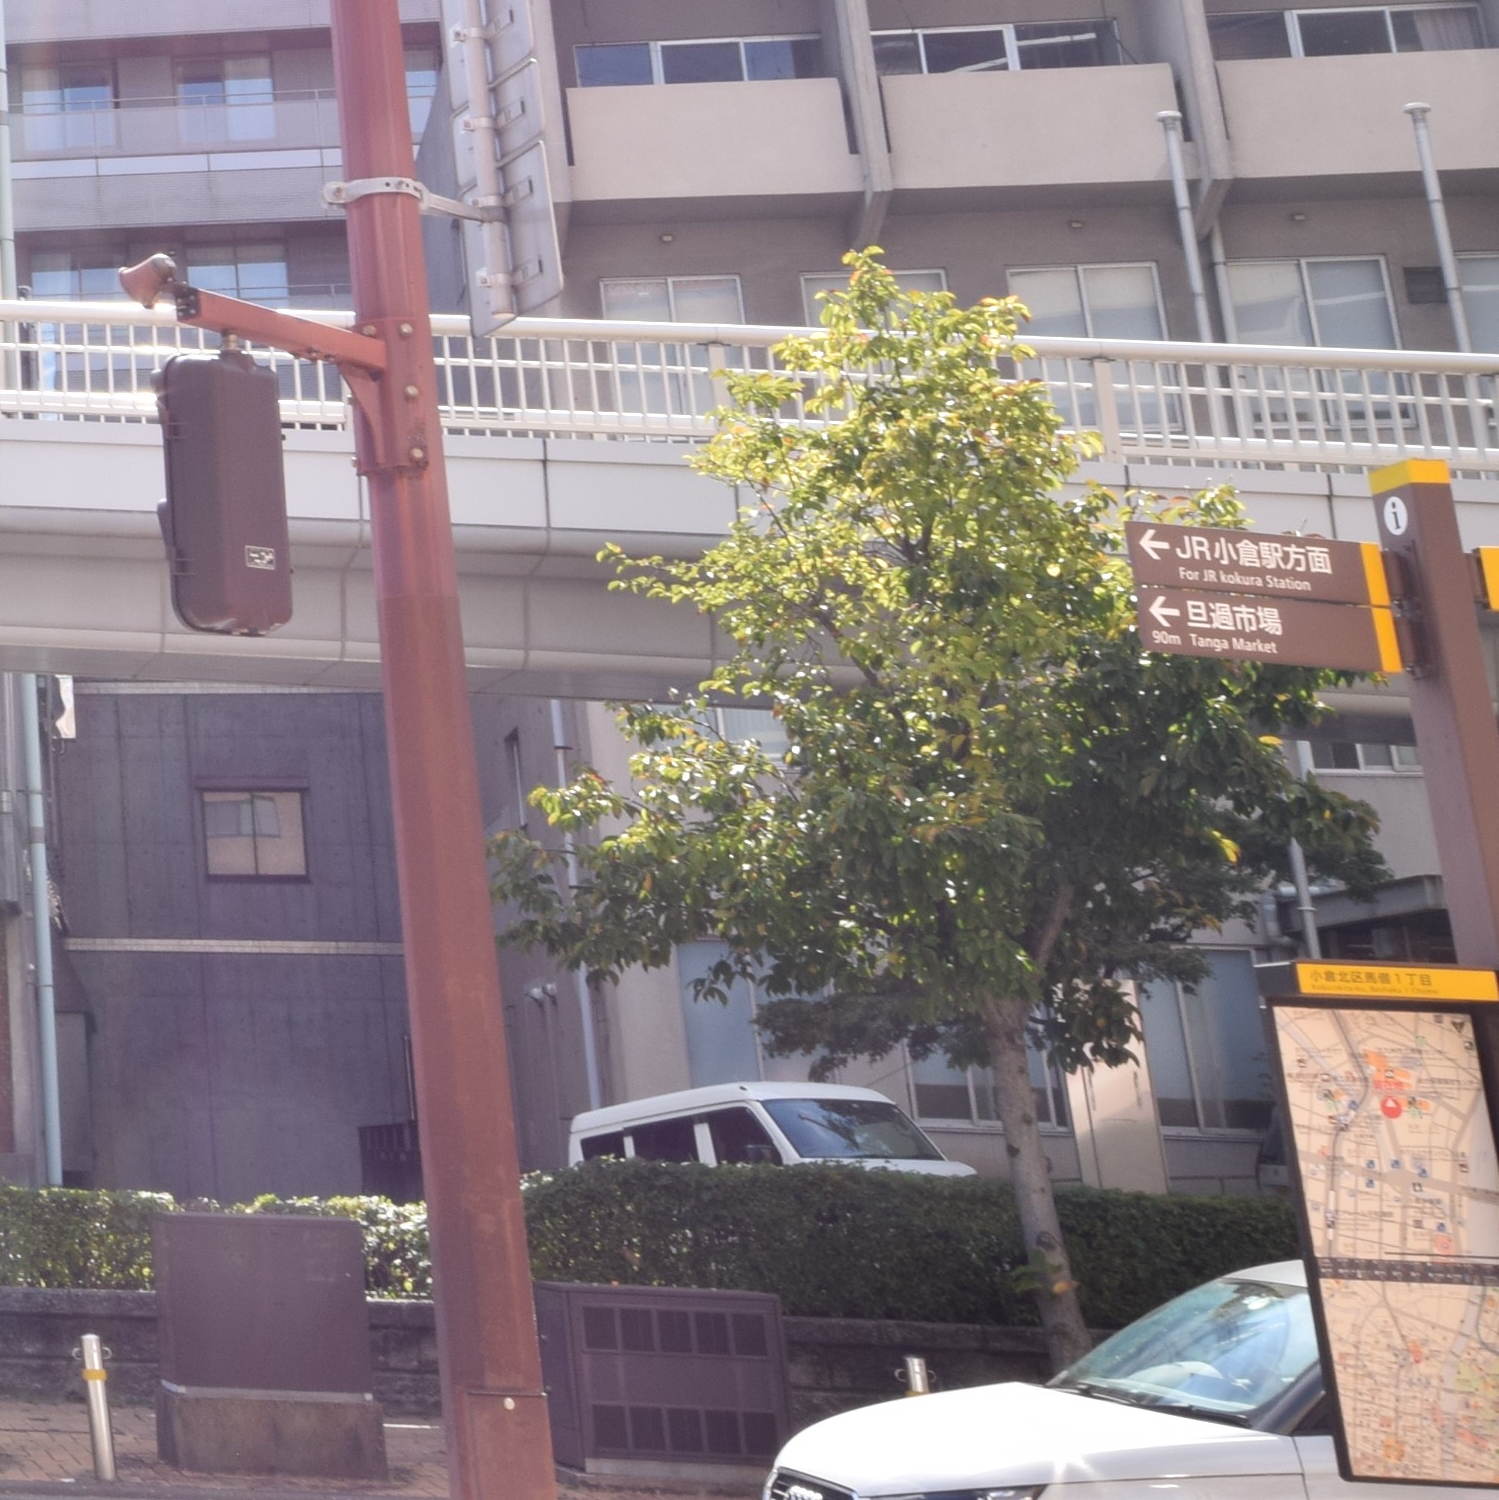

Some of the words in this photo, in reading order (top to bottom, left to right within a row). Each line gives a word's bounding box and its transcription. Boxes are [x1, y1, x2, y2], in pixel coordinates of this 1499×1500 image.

[1175, 535, 1333, 575] JR小倉駅方面
[1178, 567, 1200, 581] For
[1203, 569, 1218, 582] JR
[1265, 575, 1312, 591] Station
[1186, 599, 1283, 636] 旦過市場
[1152, 630, 1182, 646] 90m
[1189, 633, 1230, 652] Tanga
[1232, 637, 1279, 654] Market
